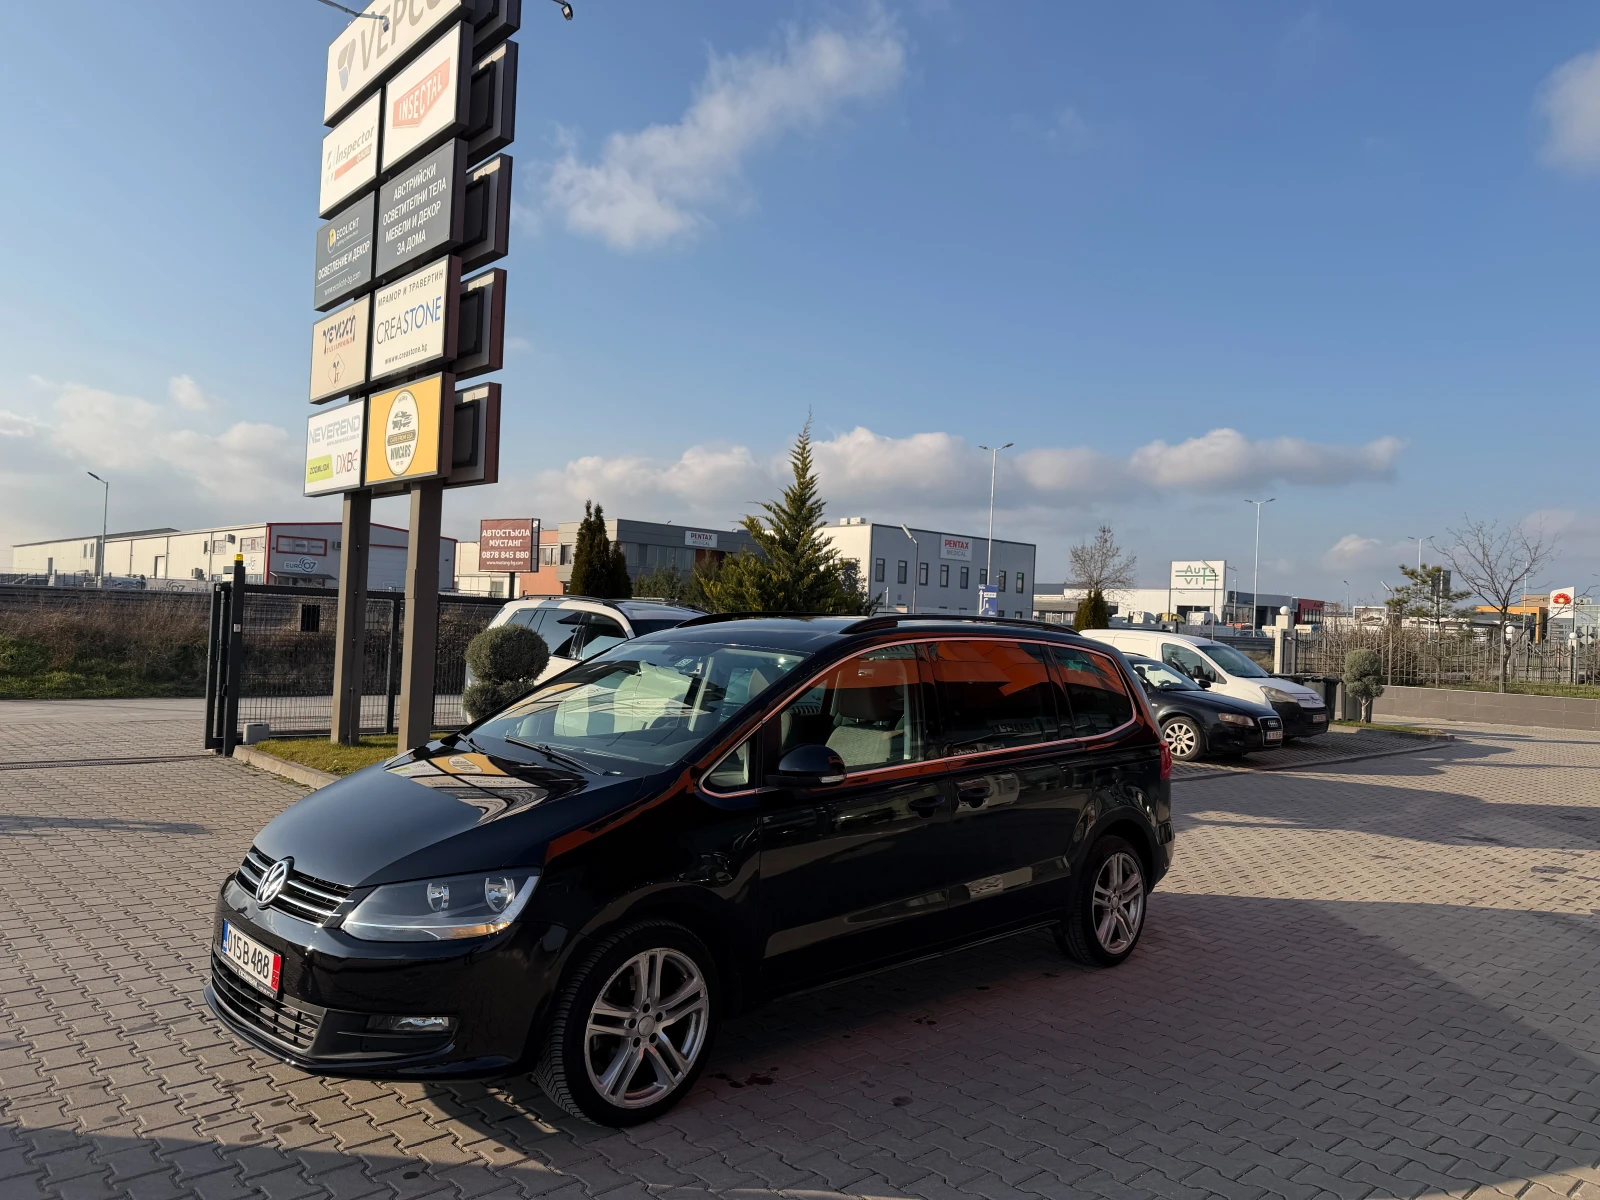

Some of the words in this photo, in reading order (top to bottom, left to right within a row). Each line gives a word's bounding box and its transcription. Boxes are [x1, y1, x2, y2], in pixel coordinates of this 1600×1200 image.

[398, 72, 442, 121] INSECTAL
[335, 126, 375, 165] Inspector
[393, 163, 437, 202] АВСТРИЙСКИ
[383, 188, 428, 226] ОСВЕТИТЕЛНИ
[429, 177, 447, 198] ТЕЛА
[385, 217, 411, 244] МЕБЕЛИ
[412, 214, 417, 228] И
[417, 200, 442, 227] ДЕКОР
[396, 240, 406, 256] ЗА
[406, 229, 426, 254] ДОМА
[377, 289, 401, 308] МРАМОР
[409, 269, 444, 293] ТРАВЕРТИН
[376, 296, 442, 345] CREASTONE
[309, 415, 361, 445] NEVEREND
[482, 529, 531, 537] АВТОСТЪКЛА
[489, 539, 523, 547] МУСТАНГ
[690, 532, 713, 541] PENTAX
[944, 539, 969, 550] PENTAX
[481, 551, 499, 559] 0878
[500, 551, 514, 559] 845
[515, 551, 529, 559] 880
[946, 549, 967, 557] MEDICAL
